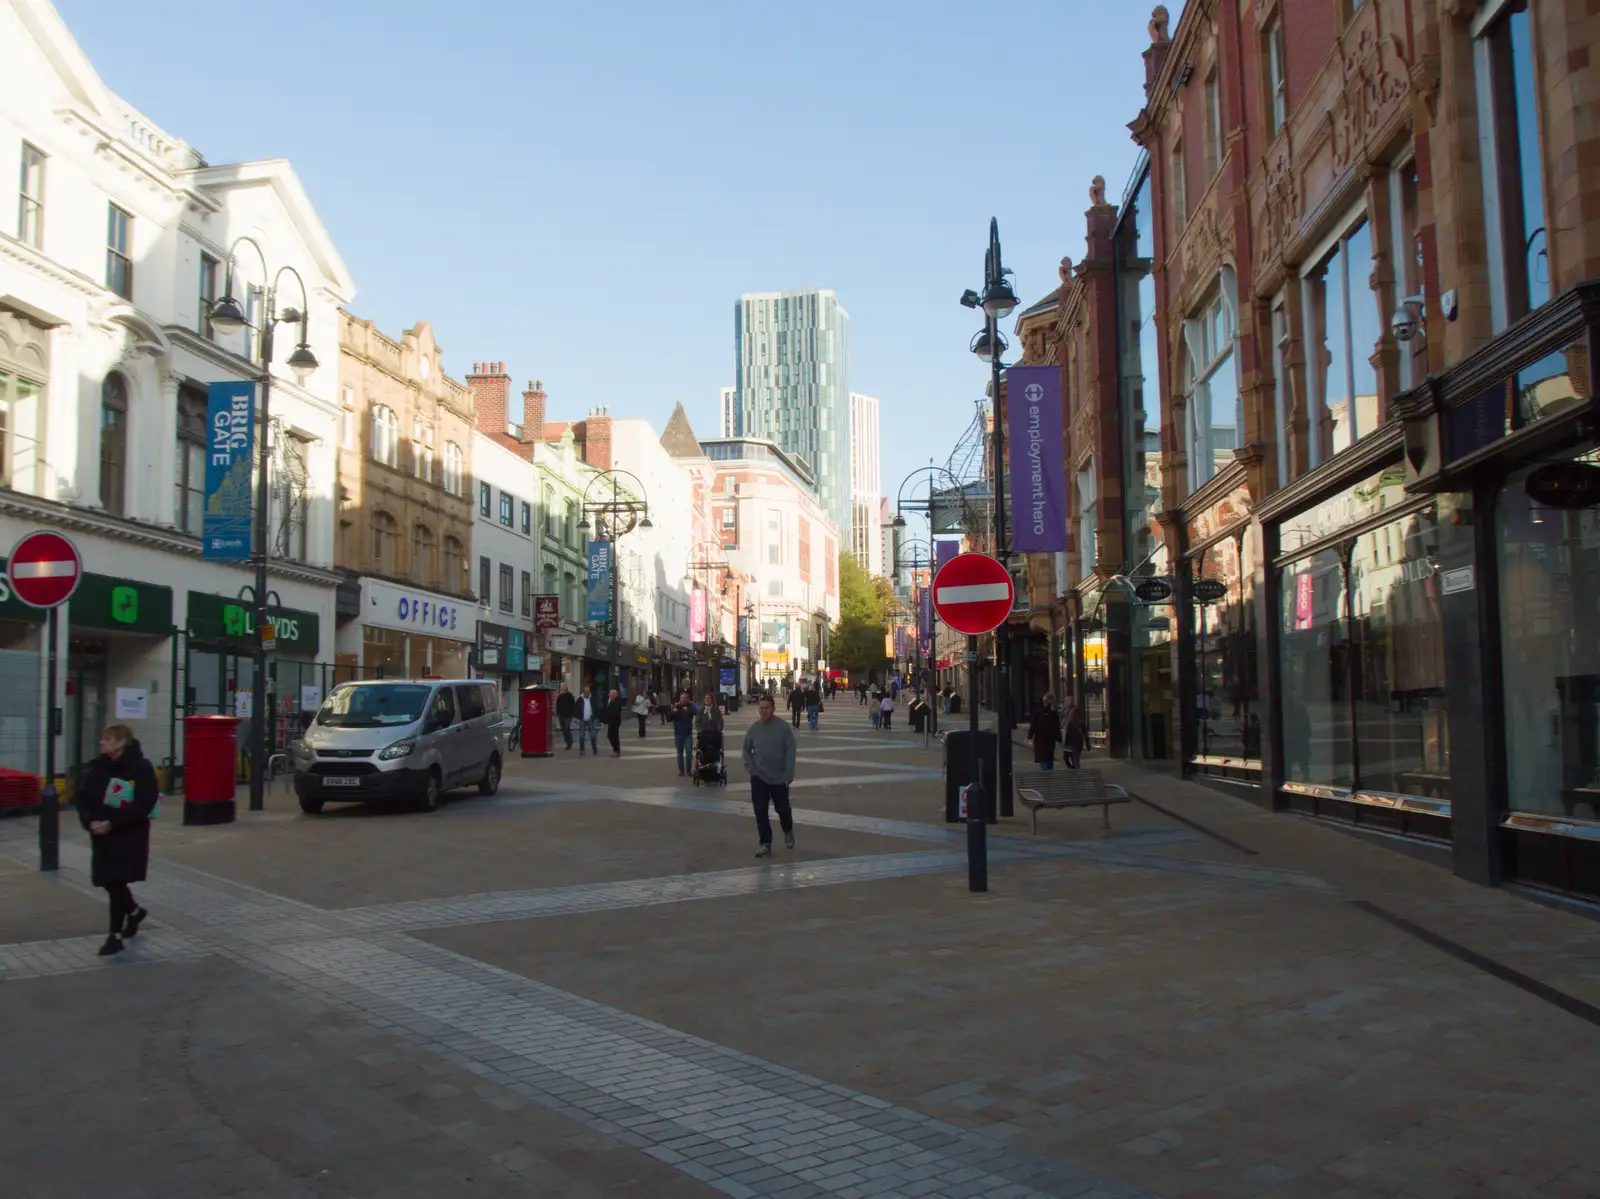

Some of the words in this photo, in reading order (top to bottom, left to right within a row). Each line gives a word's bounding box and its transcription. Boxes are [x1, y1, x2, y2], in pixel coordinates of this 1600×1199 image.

[212, 411, 231, 466] GATE
[231, 395, 249, 449] BRIG
[1027, 405, 1044, 500] employment
[1031, 501, 1046, 535] hero
[590, 554, 599, 580] GATE
[245, 612, 299, 640] LYDS
[399, 597, 457, 630] OFFICE
